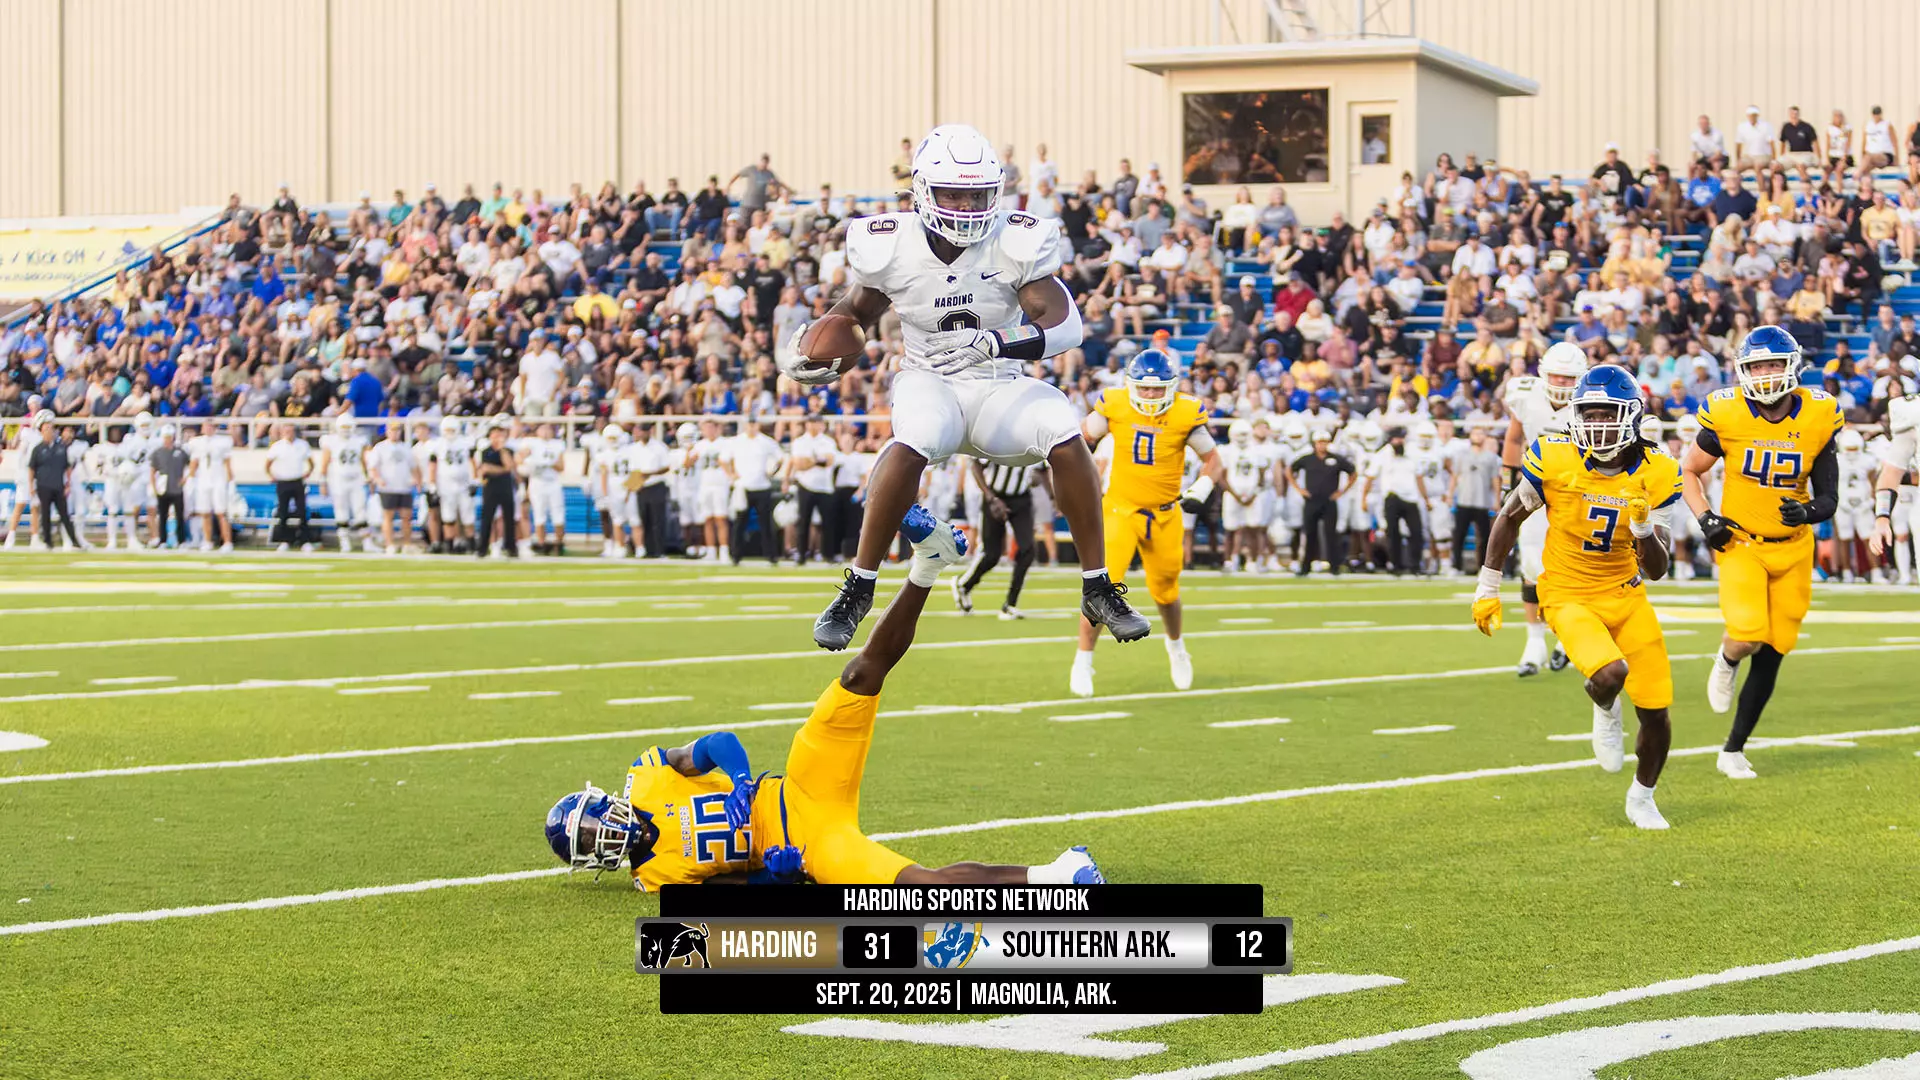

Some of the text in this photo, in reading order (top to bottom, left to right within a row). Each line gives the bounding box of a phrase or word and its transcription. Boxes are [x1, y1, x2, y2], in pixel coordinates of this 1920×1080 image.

[934, 293, 974, 308] HARDING
[1133, 430, 1156, 466] 0
[1741, 447, 1803, 490] 42
[1581, 493, 1629, 508] MULERIDERS
[1582, 506, 1622, 553] 3
[680, 806, 692, 857] MULERIDERS
